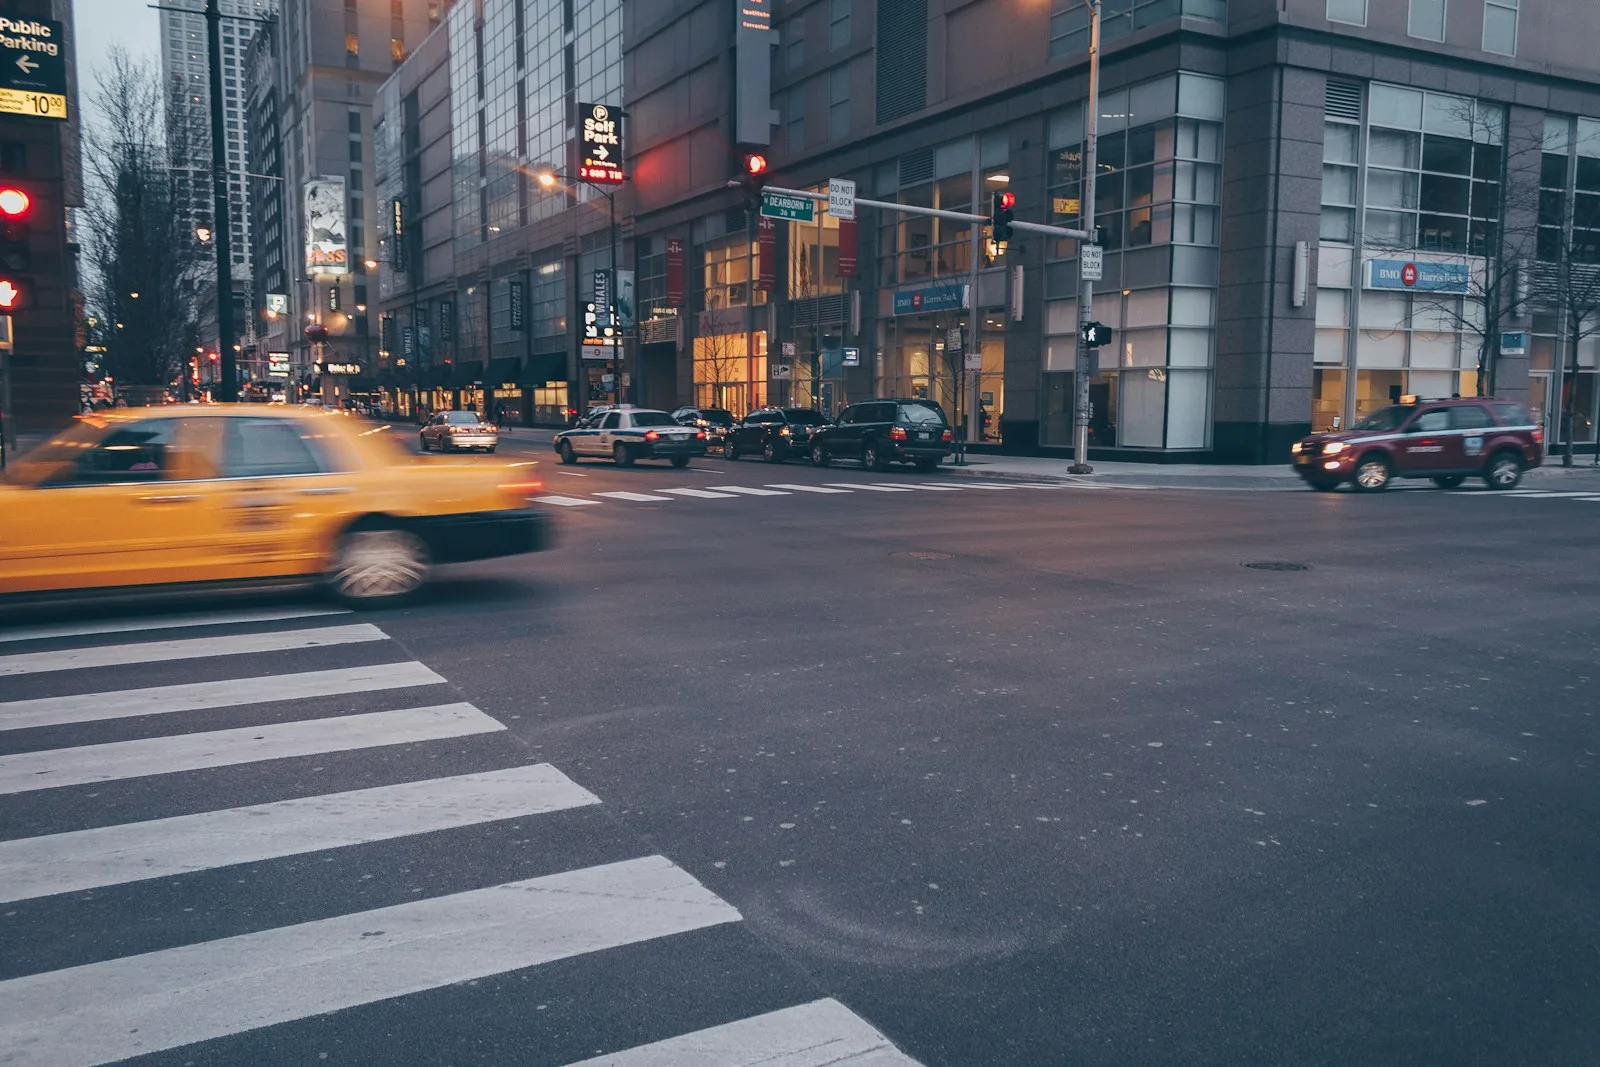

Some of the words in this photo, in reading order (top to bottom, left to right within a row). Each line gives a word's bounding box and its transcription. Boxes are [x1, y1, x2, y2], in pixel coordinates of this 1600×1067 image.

[0, 17, 51, 37] Public
[584, 118, 615, 132] Self
[584, 130, 618, 145] Park
[830, 184, 840, 192] DO
[841, 186, 853, 194] NOT
[770, 196, 805, 210] DEARBORN
[831, 195, 852, 206] BLOCK
[1083, 250, 1090, 258] DO
[1083, 261, 1101, 269] BLOCK
[1380, 269, 1400, 279] BMO
[595, 272, 605, 313] WHALES
